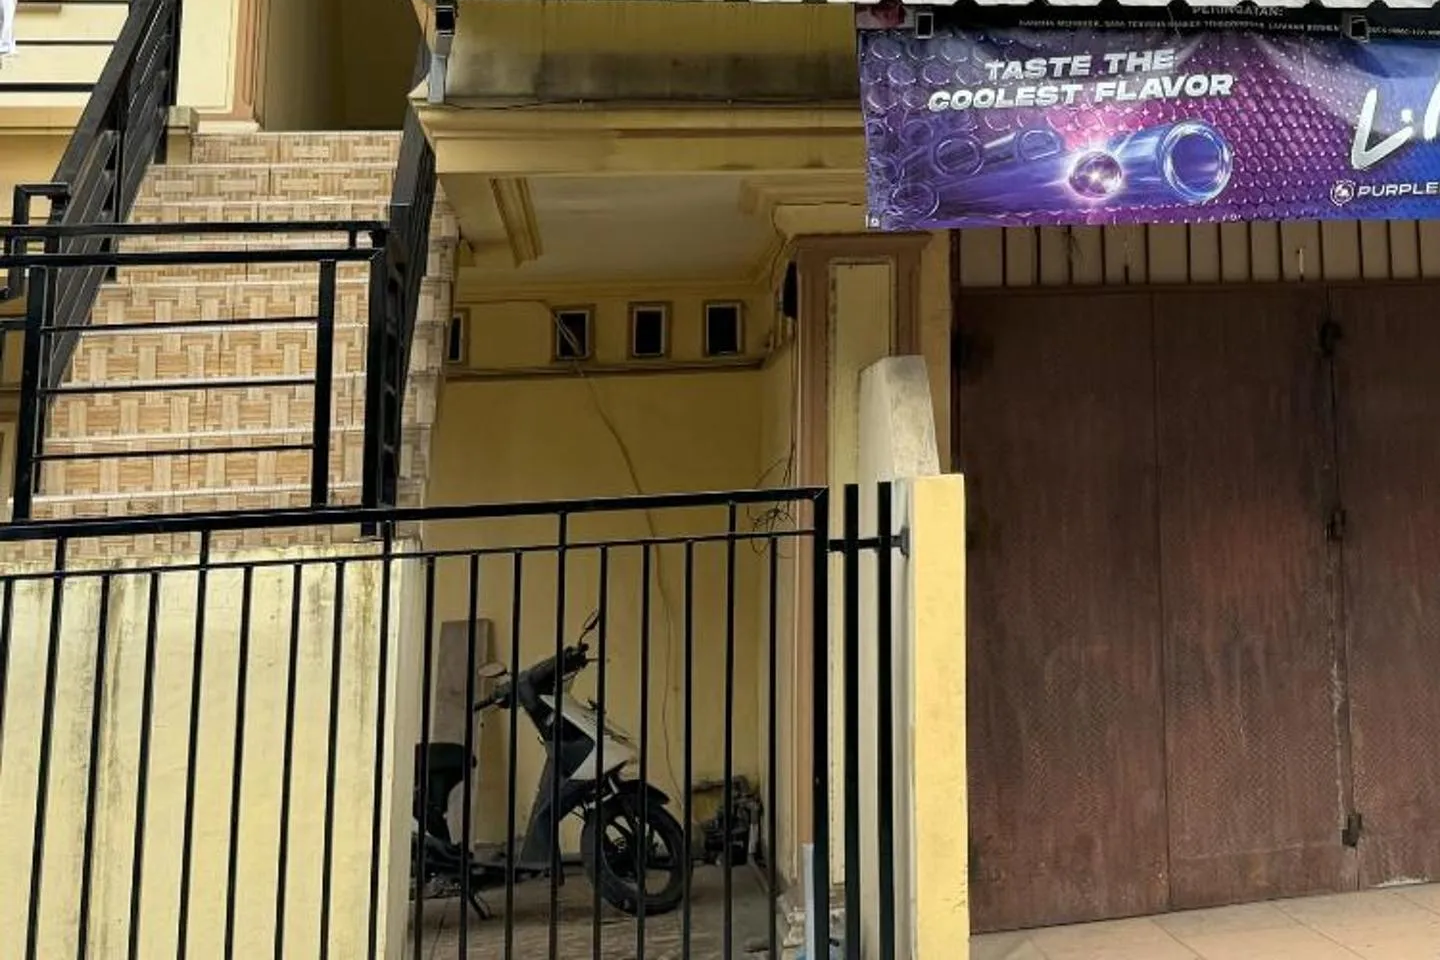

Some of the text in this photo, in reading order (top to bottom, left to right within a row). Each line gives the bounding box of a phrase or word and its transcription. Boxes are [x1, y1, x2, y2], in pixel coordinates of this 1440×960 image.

[984, 48, 1177, 82] TASTE THE
[926, 73, 1236, 112] COOLEST FLAVOR
